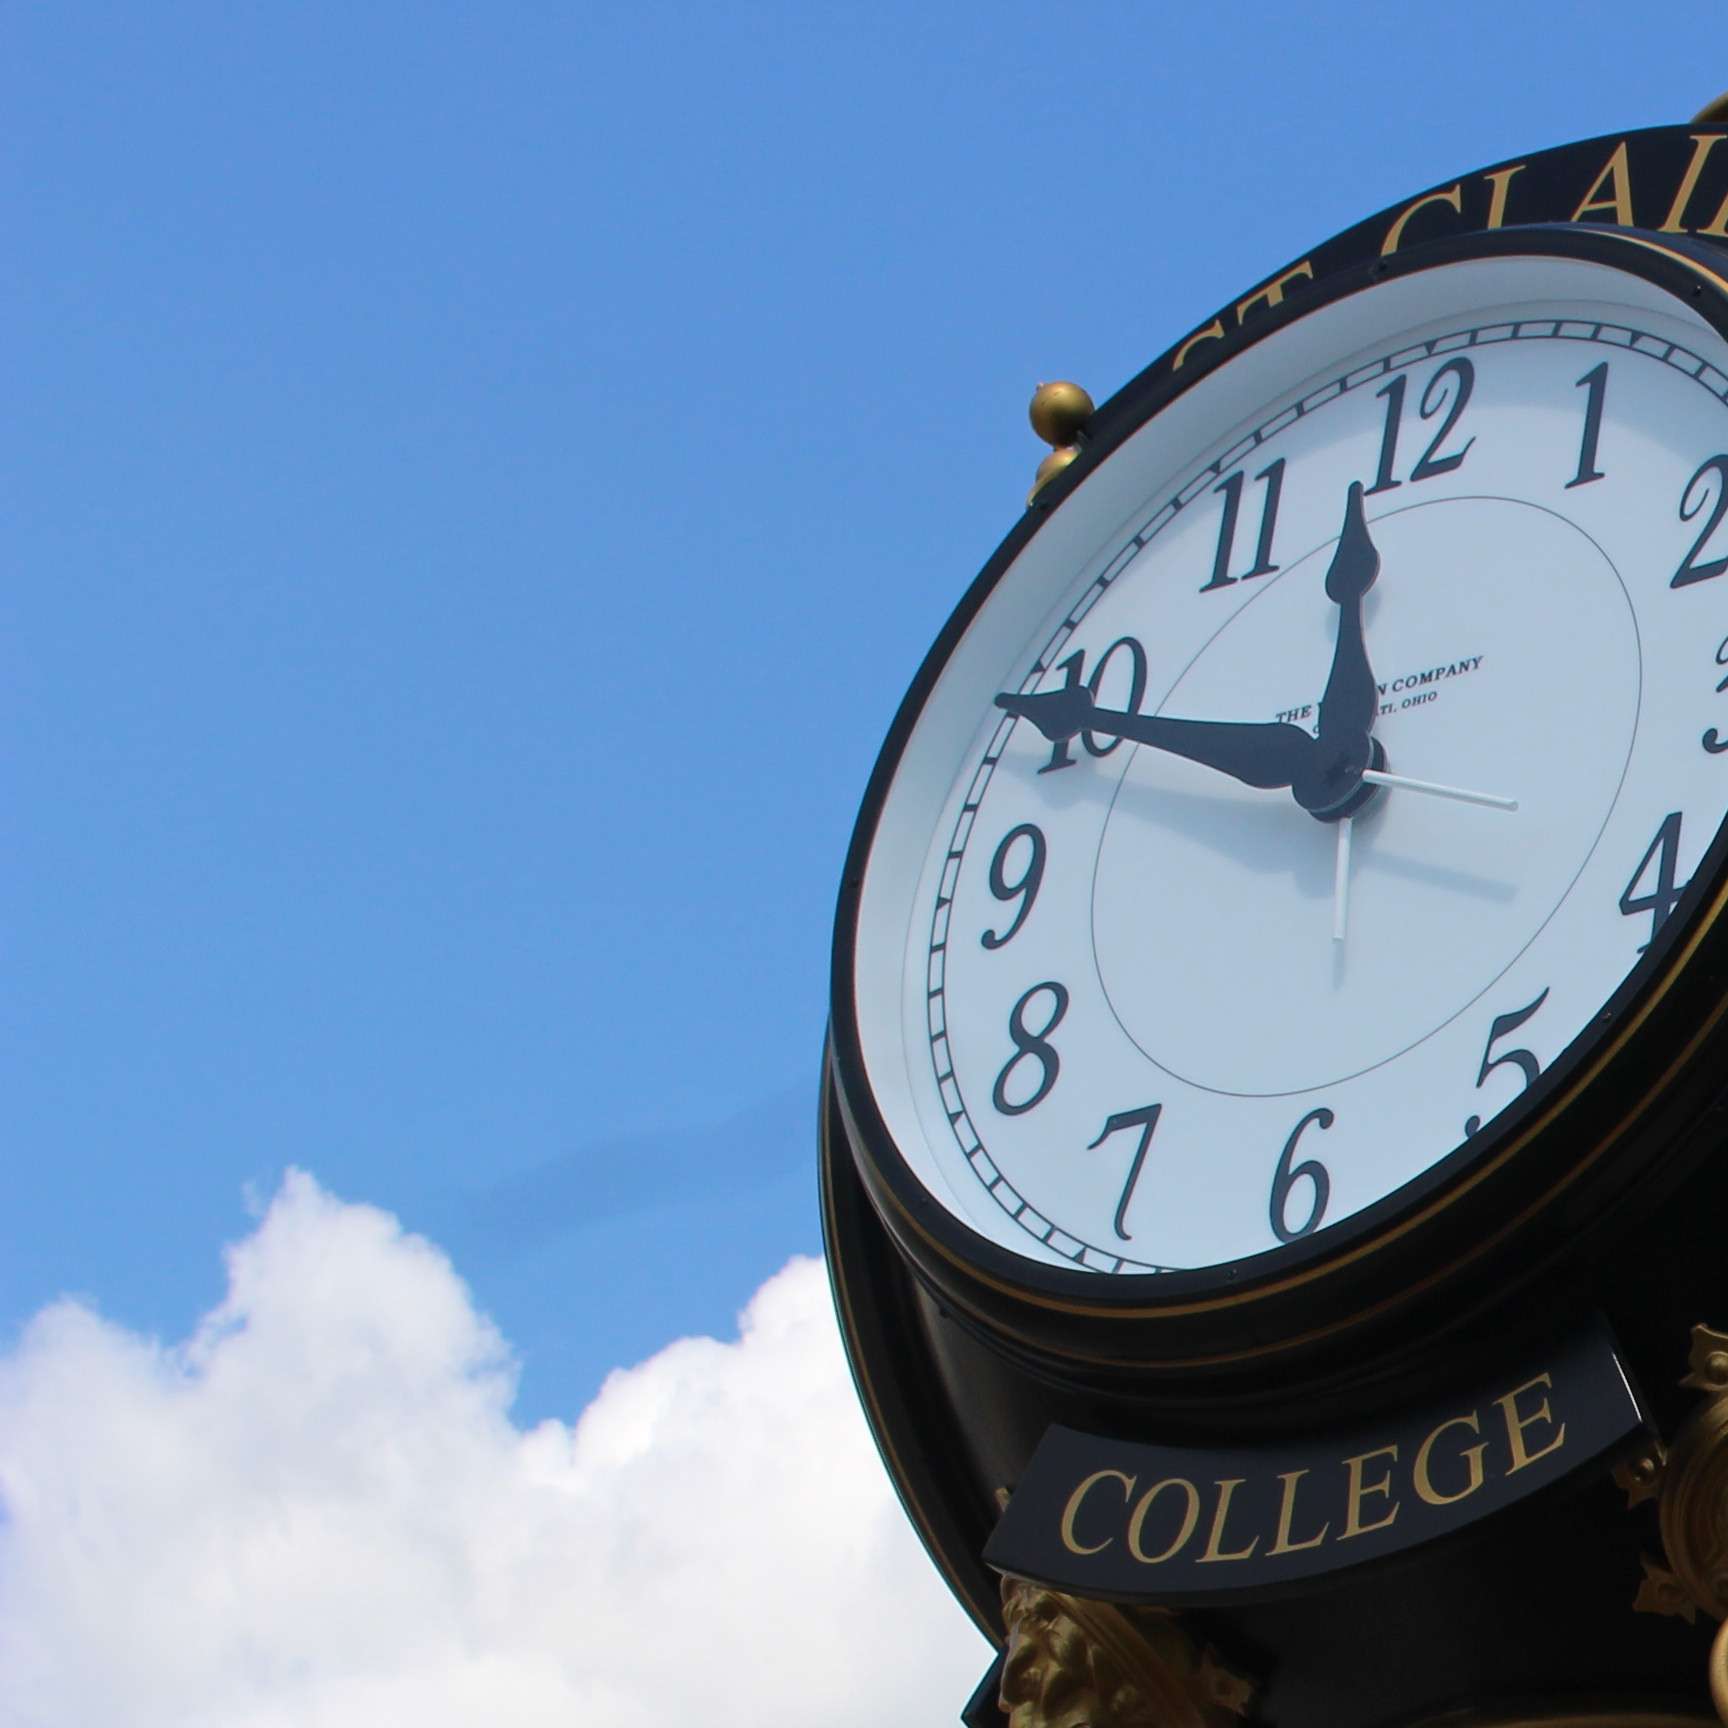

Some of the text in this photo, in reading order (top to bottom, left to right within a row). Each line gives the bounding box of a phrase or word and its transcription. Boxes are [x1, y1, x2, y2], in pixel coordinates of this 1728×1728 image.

[1361, 356, 1478, 497] 12
[1563, 361, 1612, 490] 1
[1199, 458, 1288, 594] 11
[1036, 635, 1148, 775] 10
[1391, 655, 1484, 693] COMPANY
[1401, 690, 1438, 709] OHIO
[980, 823, 1047, 951] 9
[1618, 810, 1692, 955] 4
[992, 981, 1070, 1117] 8
[1465, 986, 1550, 1138] 5
[1086, 1102, 1163, 1241] 7
[1269, 1106, 1332, 1243] 6
[1060, 1372, 1566, 1564] COLLEGE
